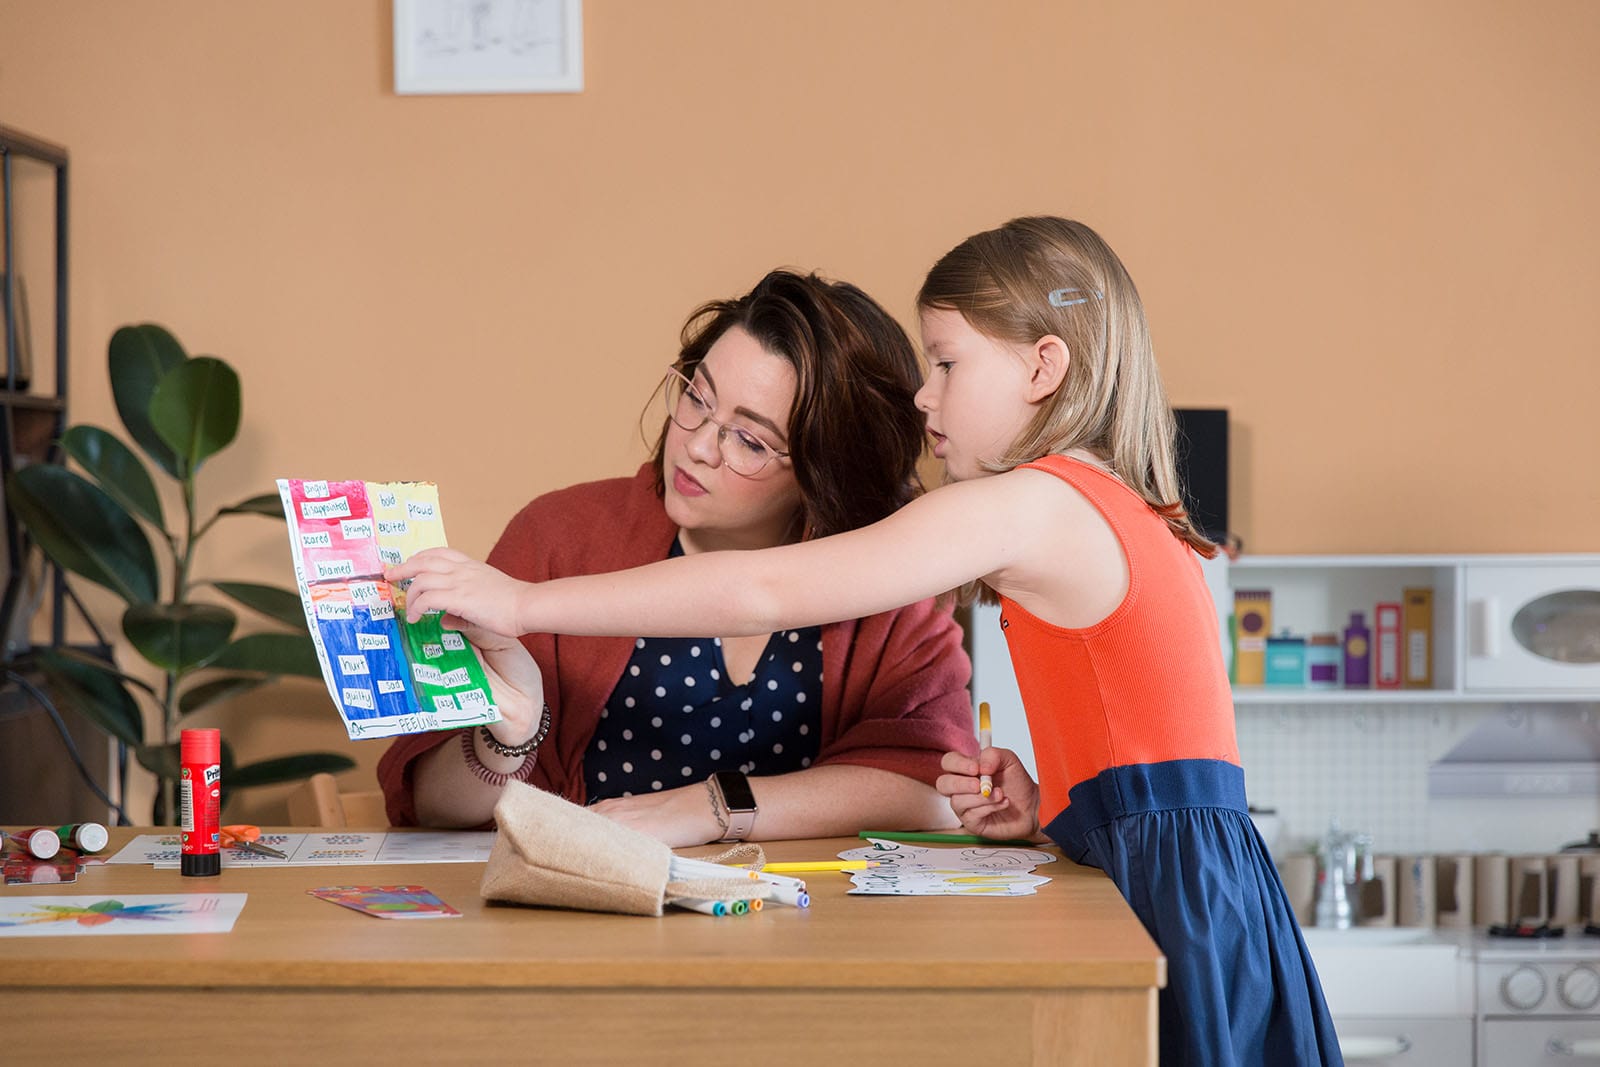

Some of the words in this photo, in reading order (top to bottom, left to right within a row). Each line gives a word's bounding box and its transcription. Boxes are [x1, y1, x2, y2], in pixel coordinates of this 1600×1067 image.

[304, 483, 328, 497] angry
[303, 500, 349, 517] disappointed
[407, 503, 433, 518] proud
[344, 524, 372, 538] grumpy
[378, 519, 406, 533] excited
[303, 534, 329, 545] scared
[379, 546, 402, 564] happy
[317, 561, 352, 577] blamed
[352, 584, 378, 601] upset
[319, 602, 351, 615] nervous
[371, 601, 393, 617] bored
[359, 636, 388, 649] jealous
[342, 660, 366, 671] hurt
[386, 680, 400, 690] sad
[345, 690, 372, 708] guilty
[399, 714, 438, 732] FEELING
